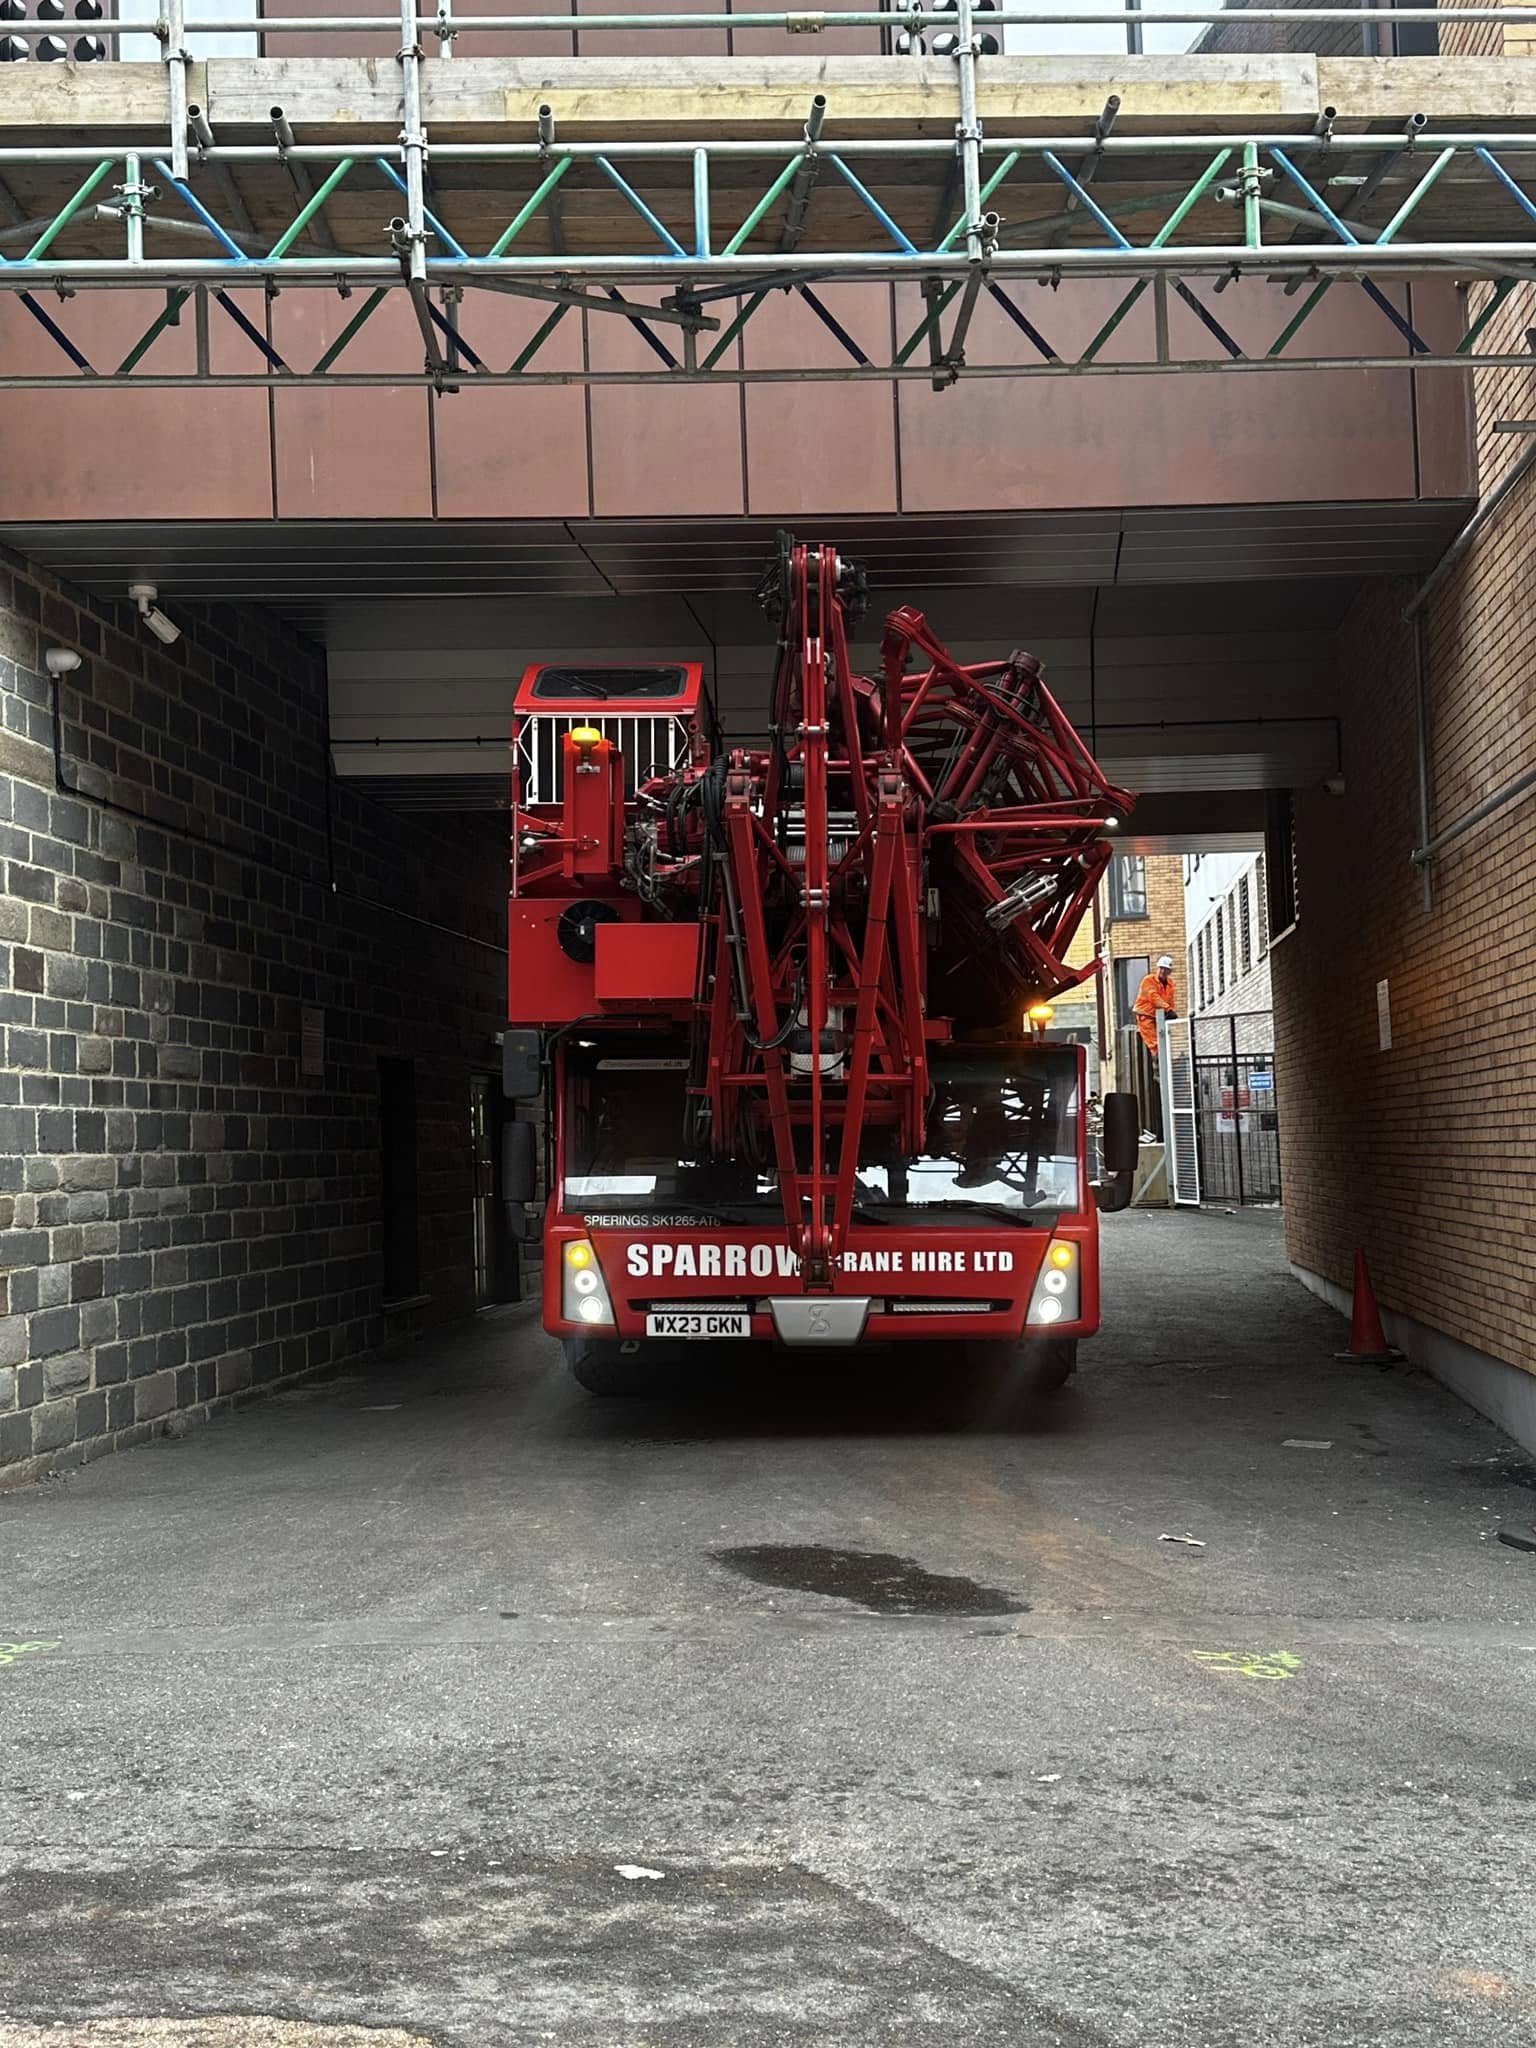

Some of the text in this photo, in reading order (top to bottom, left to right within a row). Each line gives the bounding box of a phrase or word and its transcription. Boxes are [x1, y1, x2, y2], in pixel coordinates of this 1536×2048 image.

[583, 1214, 649, 1226] SPIERINGS
[911, 1251, 966, 1272] HIRE
[973, 1251, 1014, 1272] LTD
[654, 1316, 742, 1333] WX23 GKN
